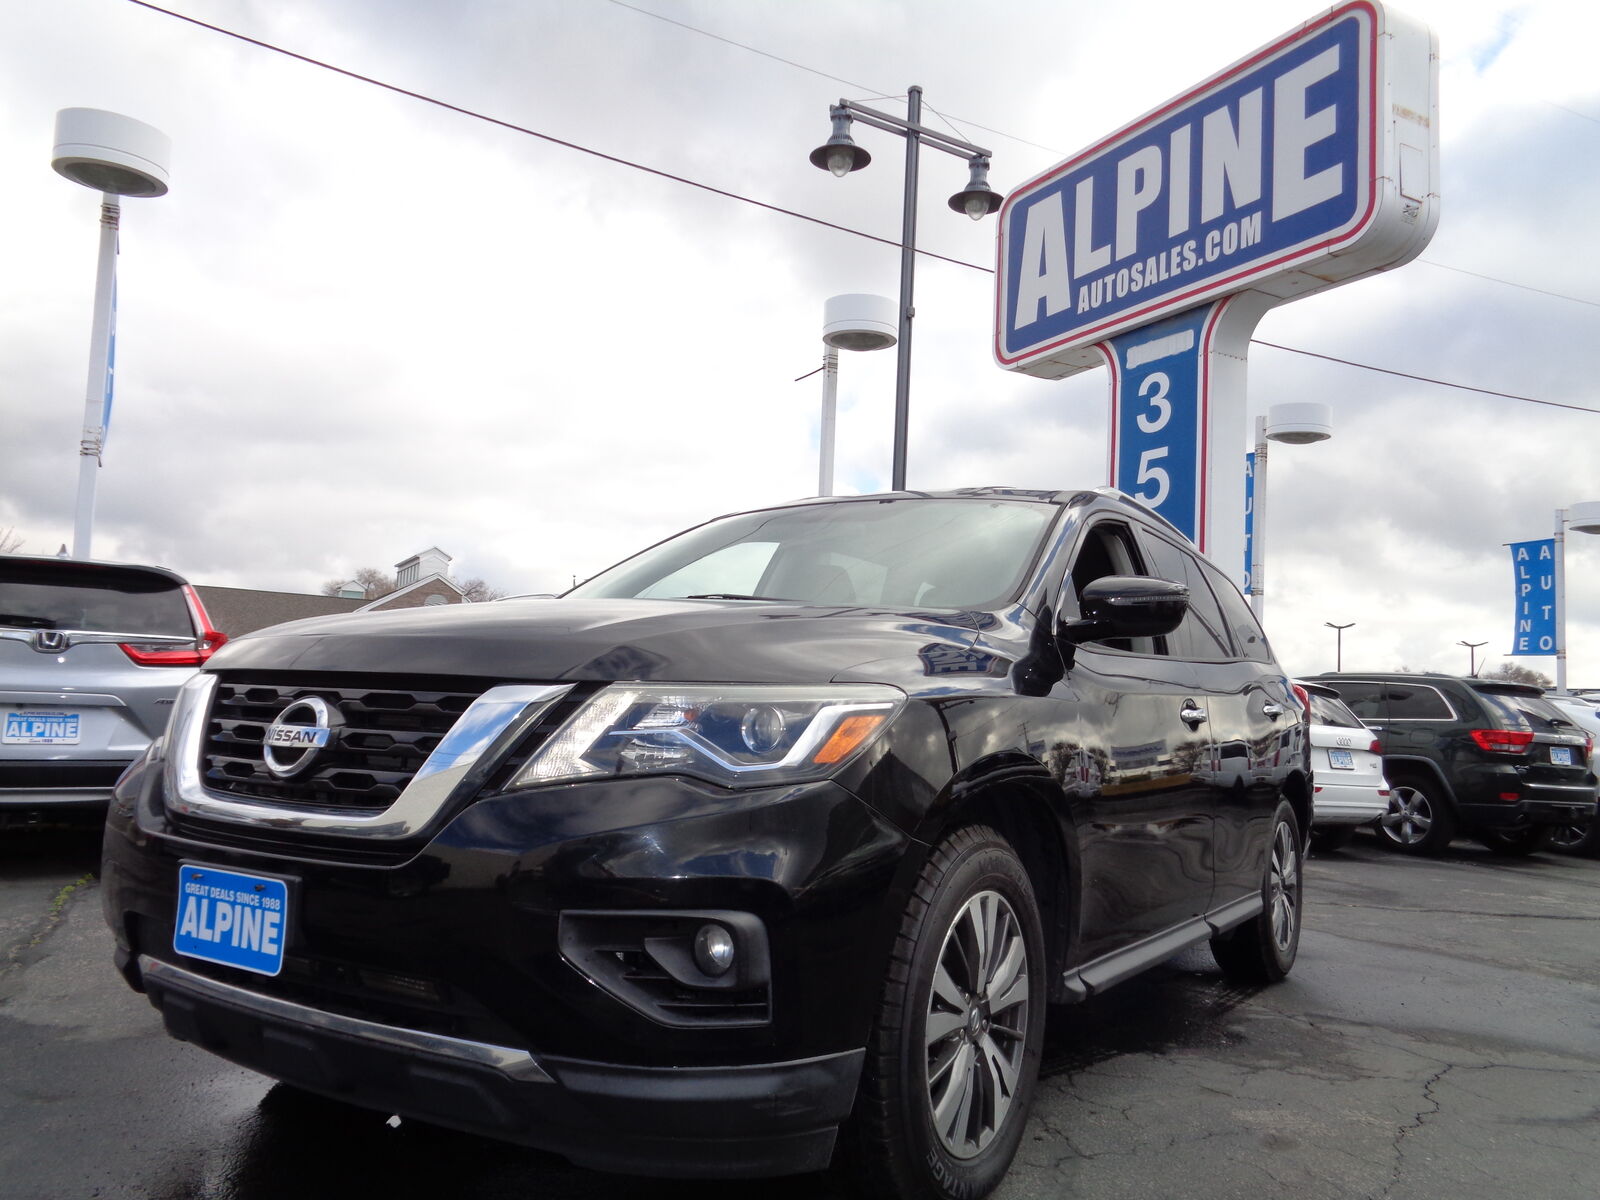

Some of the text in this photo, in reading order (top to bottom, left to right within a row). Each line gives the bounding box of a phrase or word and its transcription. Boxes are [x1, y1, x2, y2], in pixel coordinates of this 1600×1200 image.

[1014, 44, 1343, 330] ALPINE
[1077, 211, 1262, 315] AUTOSALES.COM
[1517, 547, 1531, 650] ALPINE
[1539, 545, 1552, 650] AUTO
[6, 721, 78, 738] ALPINE
[267, 727, 317, 744] NISSAN
[179, 895, 281, 956] ALPINE
[185, 882, 281, 911] GREAT DEALS SINCE 1988
